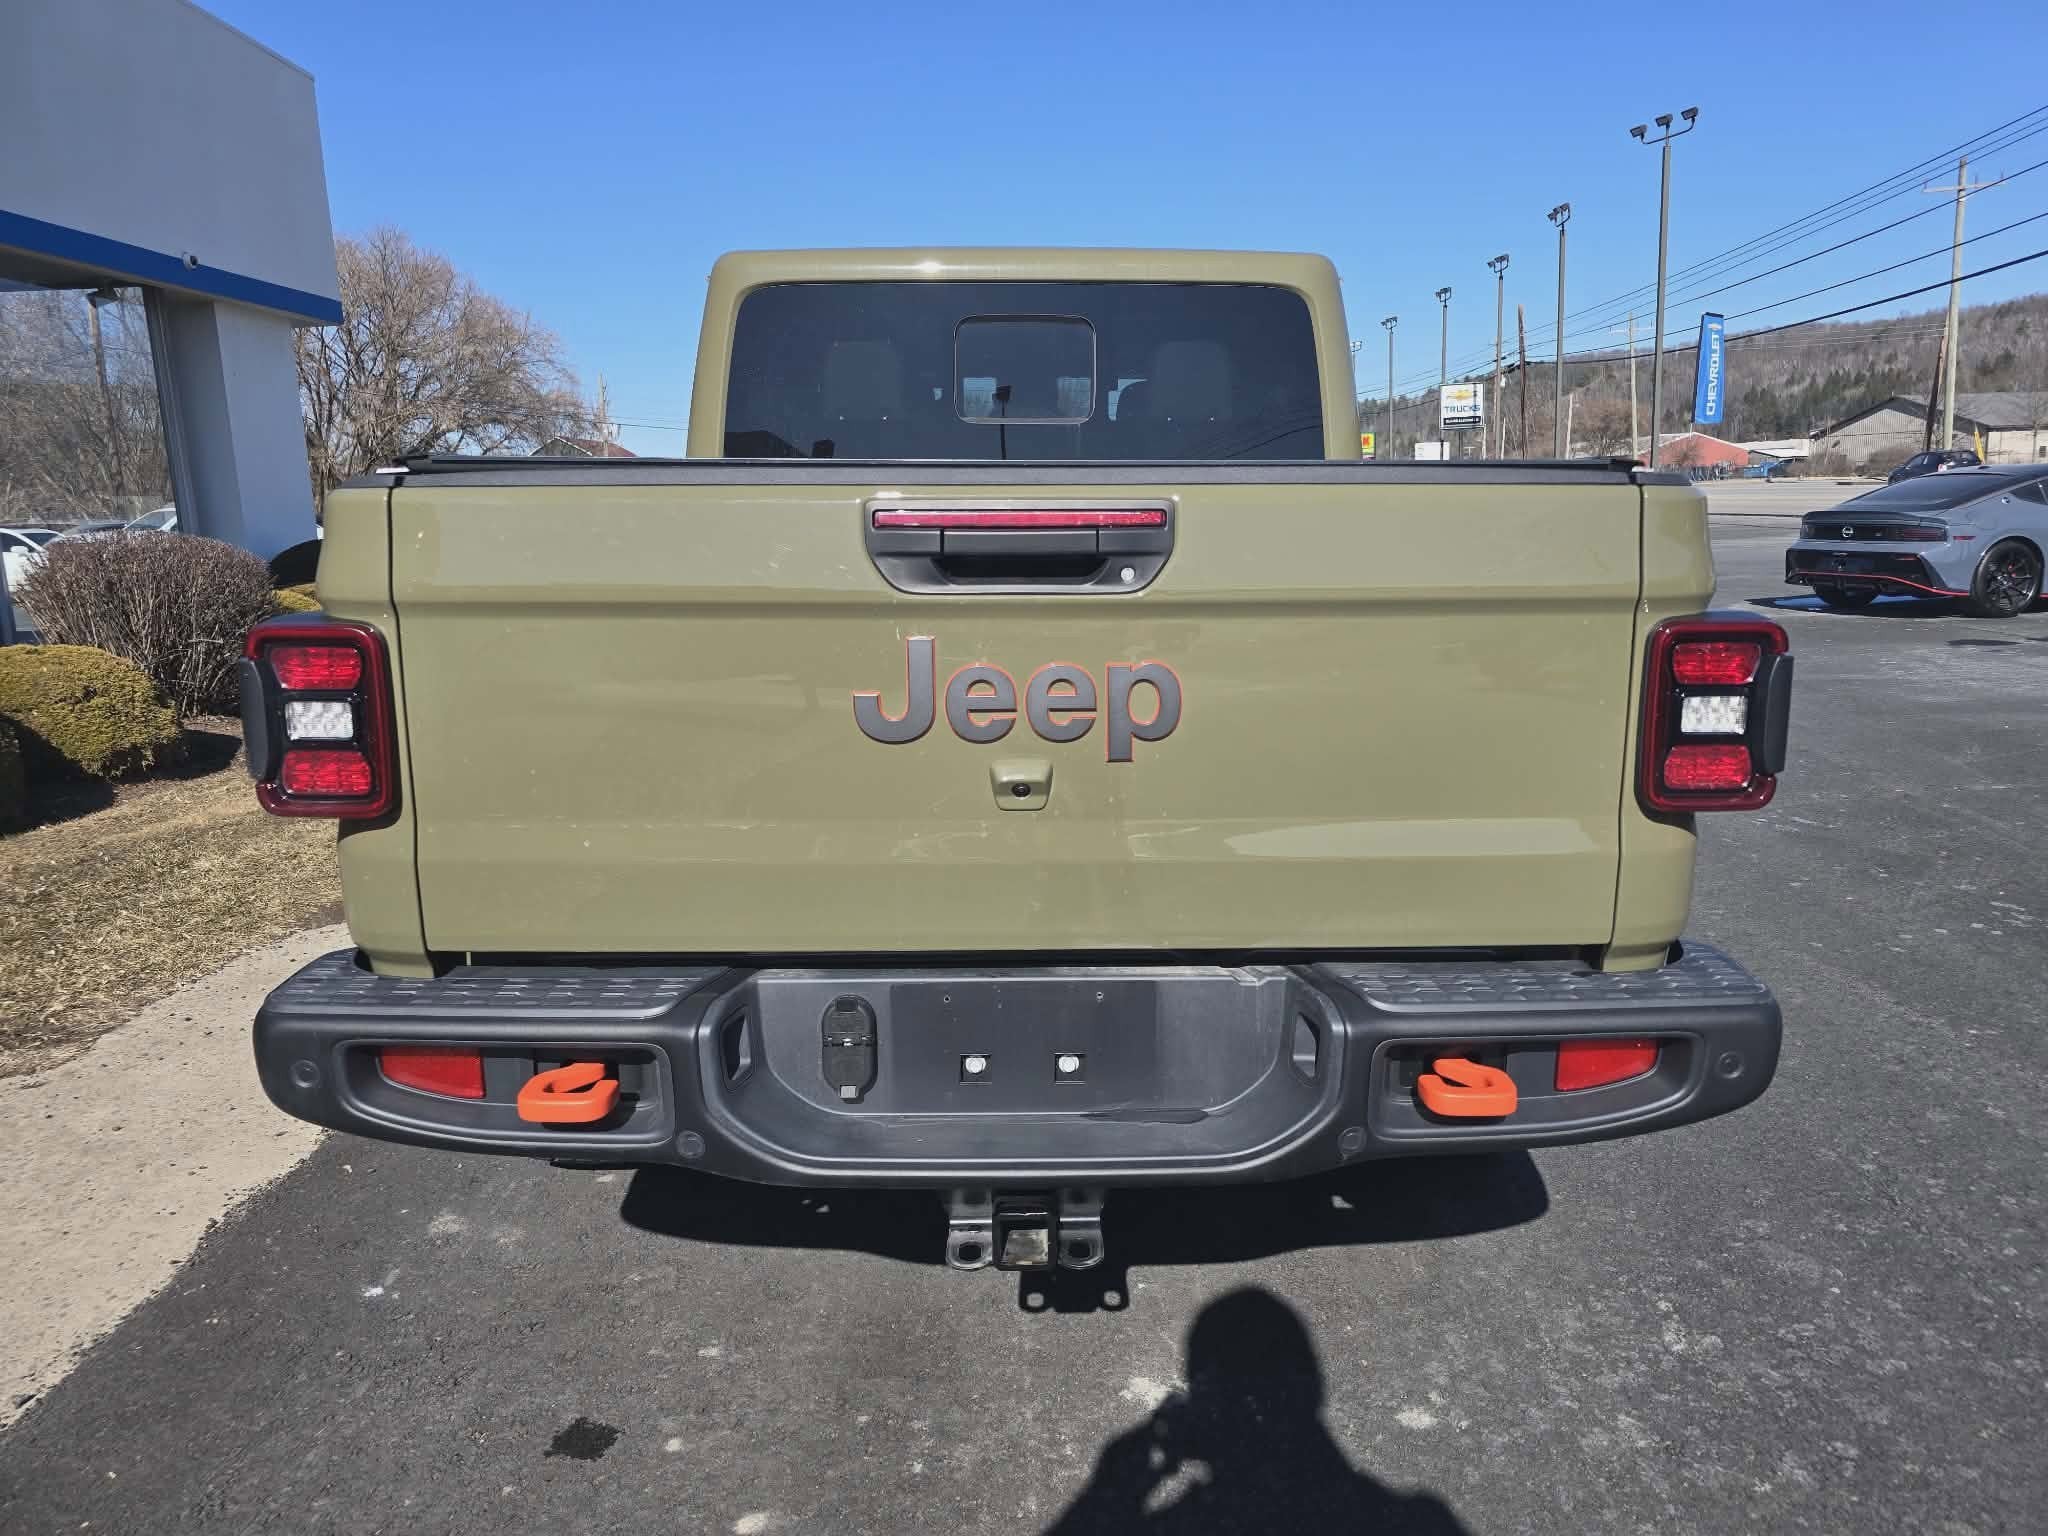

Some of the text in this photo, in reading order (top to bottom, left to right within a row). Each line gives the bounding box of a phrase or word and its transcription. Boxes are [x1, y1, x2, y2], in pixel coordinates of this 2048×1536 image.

[1443, 404, 1481, 413] TRUCKS
[1706, 332, 1720, 416] CHEVROLET
[853, 636, 1183, 763] Jeep
